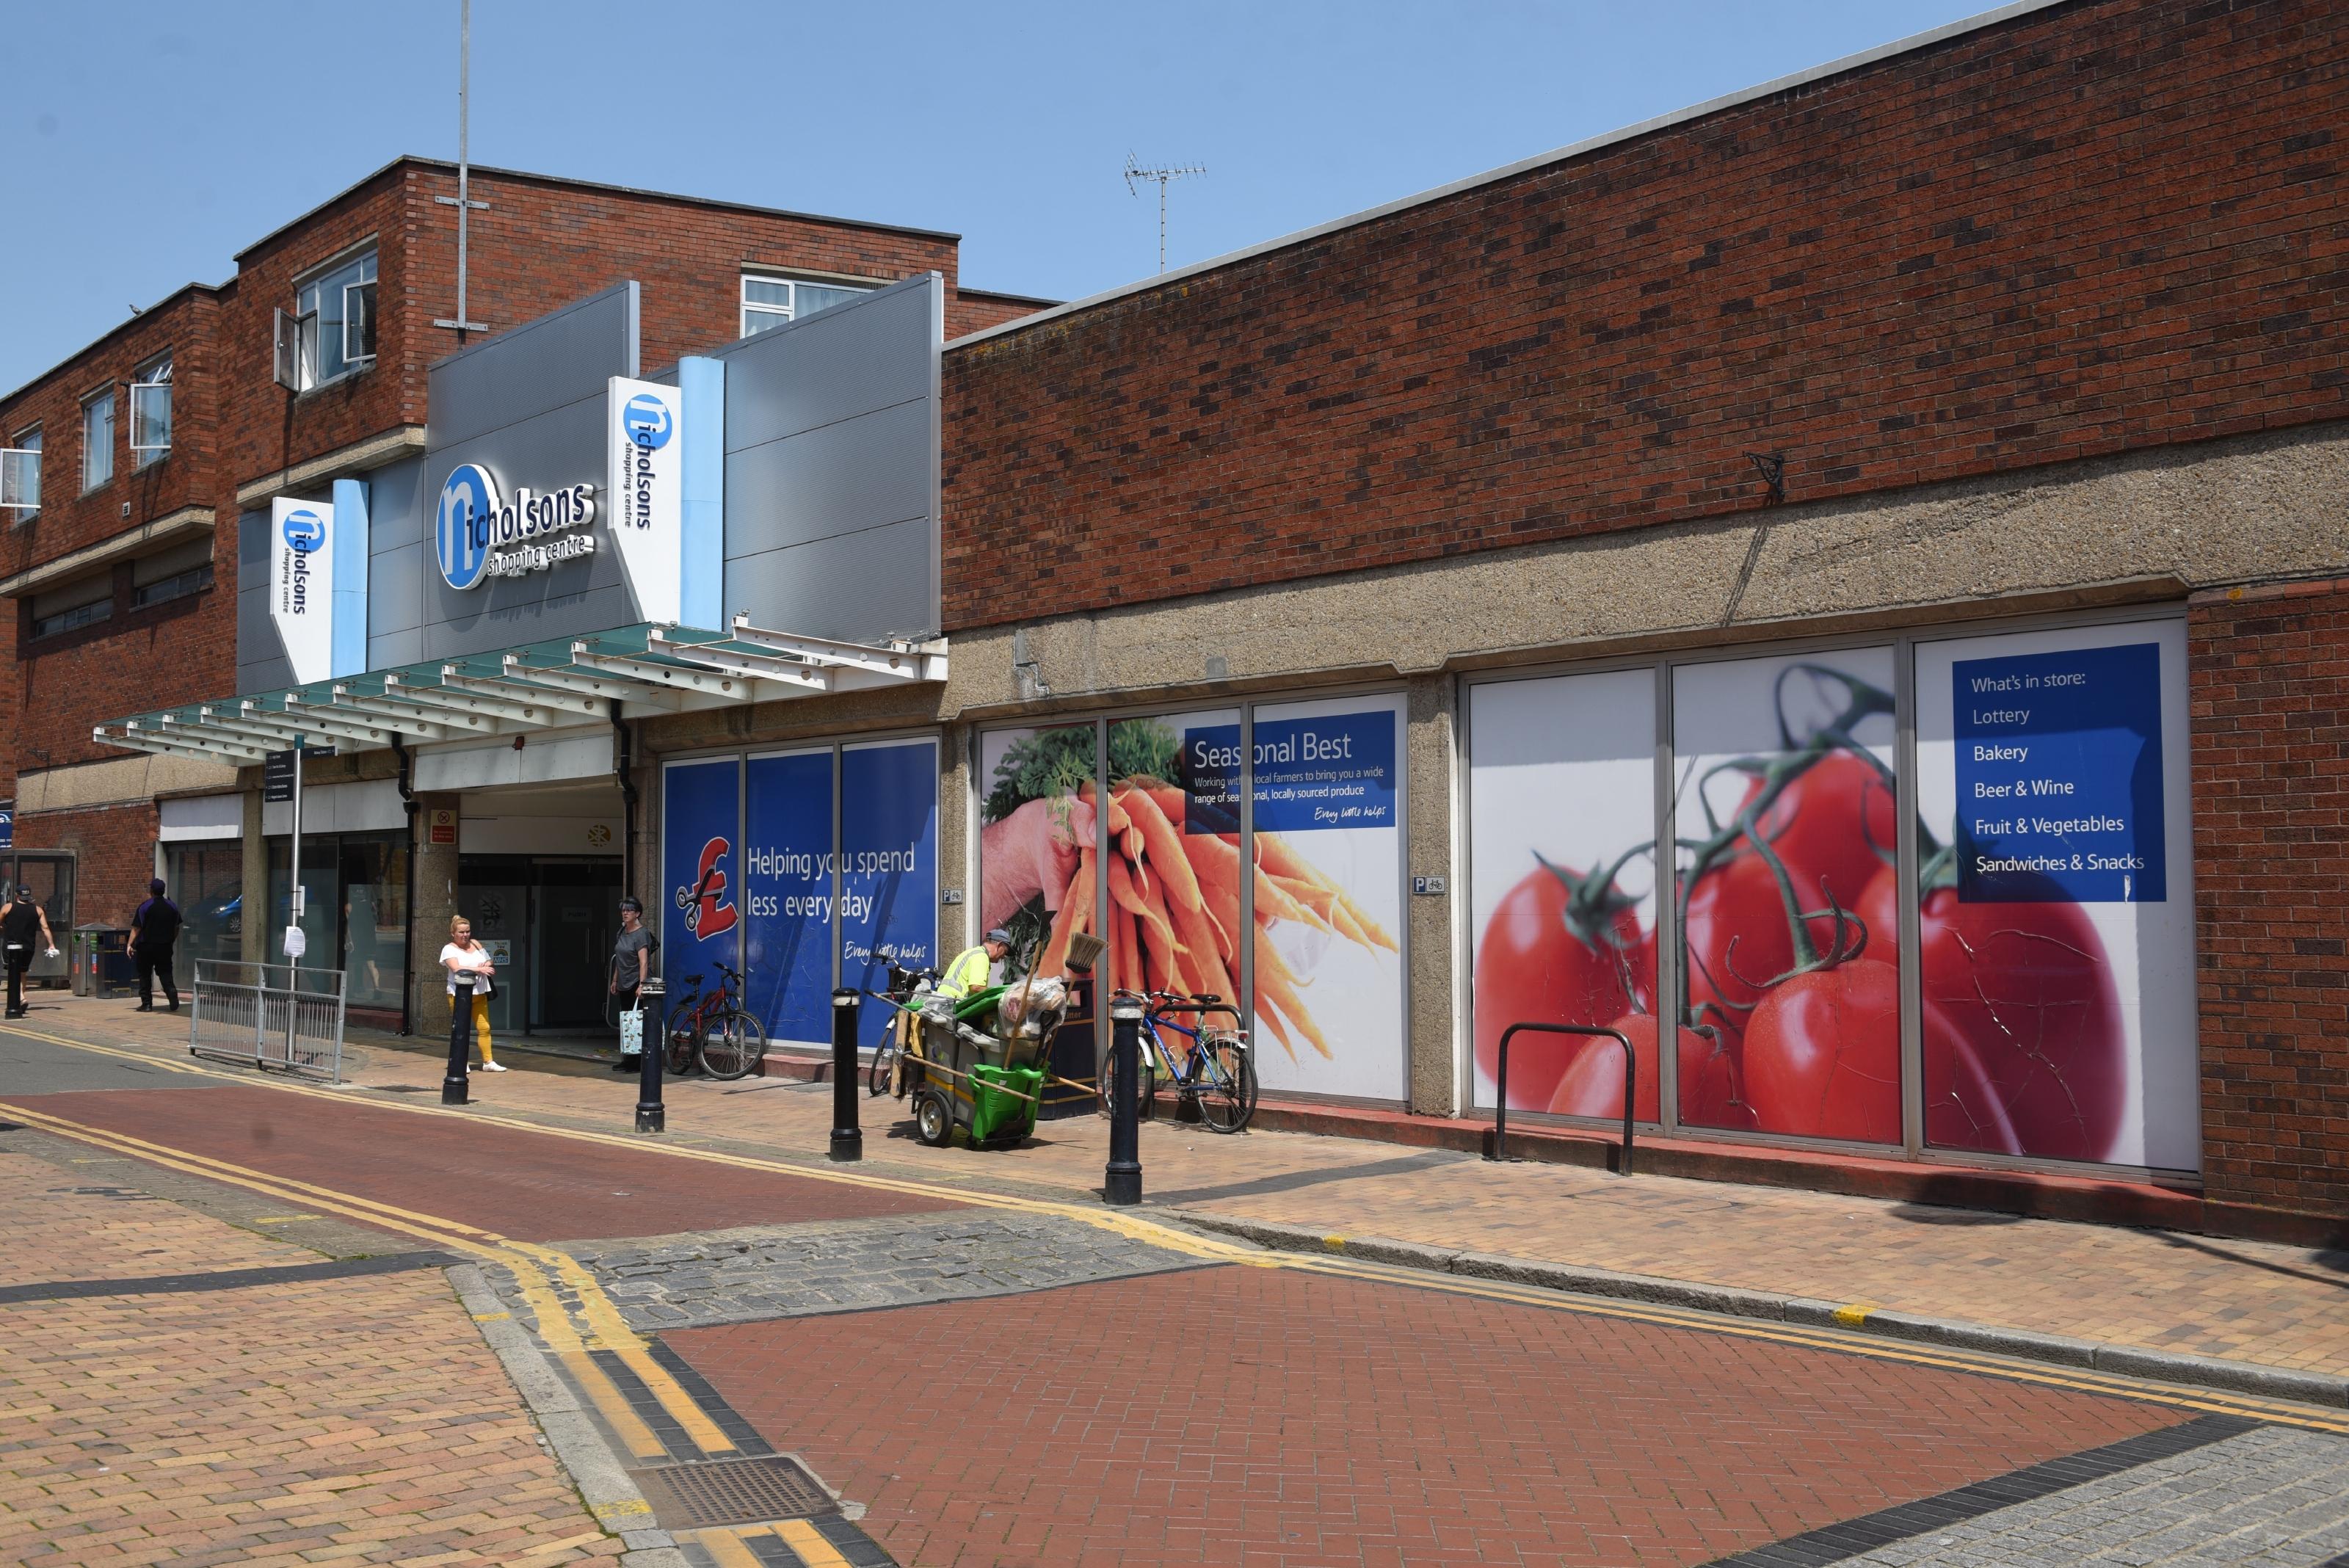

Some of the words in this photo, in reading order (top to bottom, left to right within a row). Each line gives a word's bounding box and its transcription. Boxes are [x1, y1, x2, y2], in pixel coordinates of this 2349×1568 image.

[623, 442, 633, 491] shopping
[282, 547, 291, 585] shopping
[488, 545, 541, 576] shopping
[545, 535, 586, 562] centre
[2025, 674, 2039, 689] in
[2044, 673, 2086, 688] store:
[1973, 709, 2030, 725] Lottery
[1194, 733, 1296, 769] Seasonal
[1303, 732, 1352, 761] Best
[1974, 744, 2028, 763] Bakery
[1194, 776, 1225, 789] Working
[1254, 772, 1271, 784] local
[1274, 772, 1304, 783] farmers
[1305, 772, 1314, 781] to
[1315, 769, 1337, 783] bring
[1338, 770, 1354, 783] you
[1356, 770, 1362, 778] a
[1363, 766, 1384, 777] wide
[1194, 794, 1216, 806] range
[1217, 791, 1225, 802] of
[1227, 788, 1270, 802] seaonal,
[1271, 787, 1296, 801] locally
[1297, 785, 1329, 798] sourced
[1330, 785, 1365, 799] produce
[1975, 782, 2012, 799] Beer
[2015, 780, 2027, 796] &
[2030, 779, 2074, 796] Wine
[1314, 807, 1338, 824] Every
[1340, 805, 1361, 818] little
[1363, 805, 1387, 819] helps
[1975, 819, 2012, 835] Fruit
[2016, 818, 2028, 834] &
[2031, 815, 2124, 836] Vegetables
[748, 846, 811, 882] Helping
[815, 852, 852, 881] you
[857, 841, 915, 880] spend
[1976, 855, 2067, 872] Sandwiches
[2070, 854, 2083, 871] &
[2087, 853, 2145, 871] Snacks
[1416, 877, 1425, 892] P
[747, 888, 777, 916] less
[943, 890, 949, 901] P
[844, 940, 871, 966] Every
[875, 942, 898, 959] little
[900, 943, 926, 963] helps
